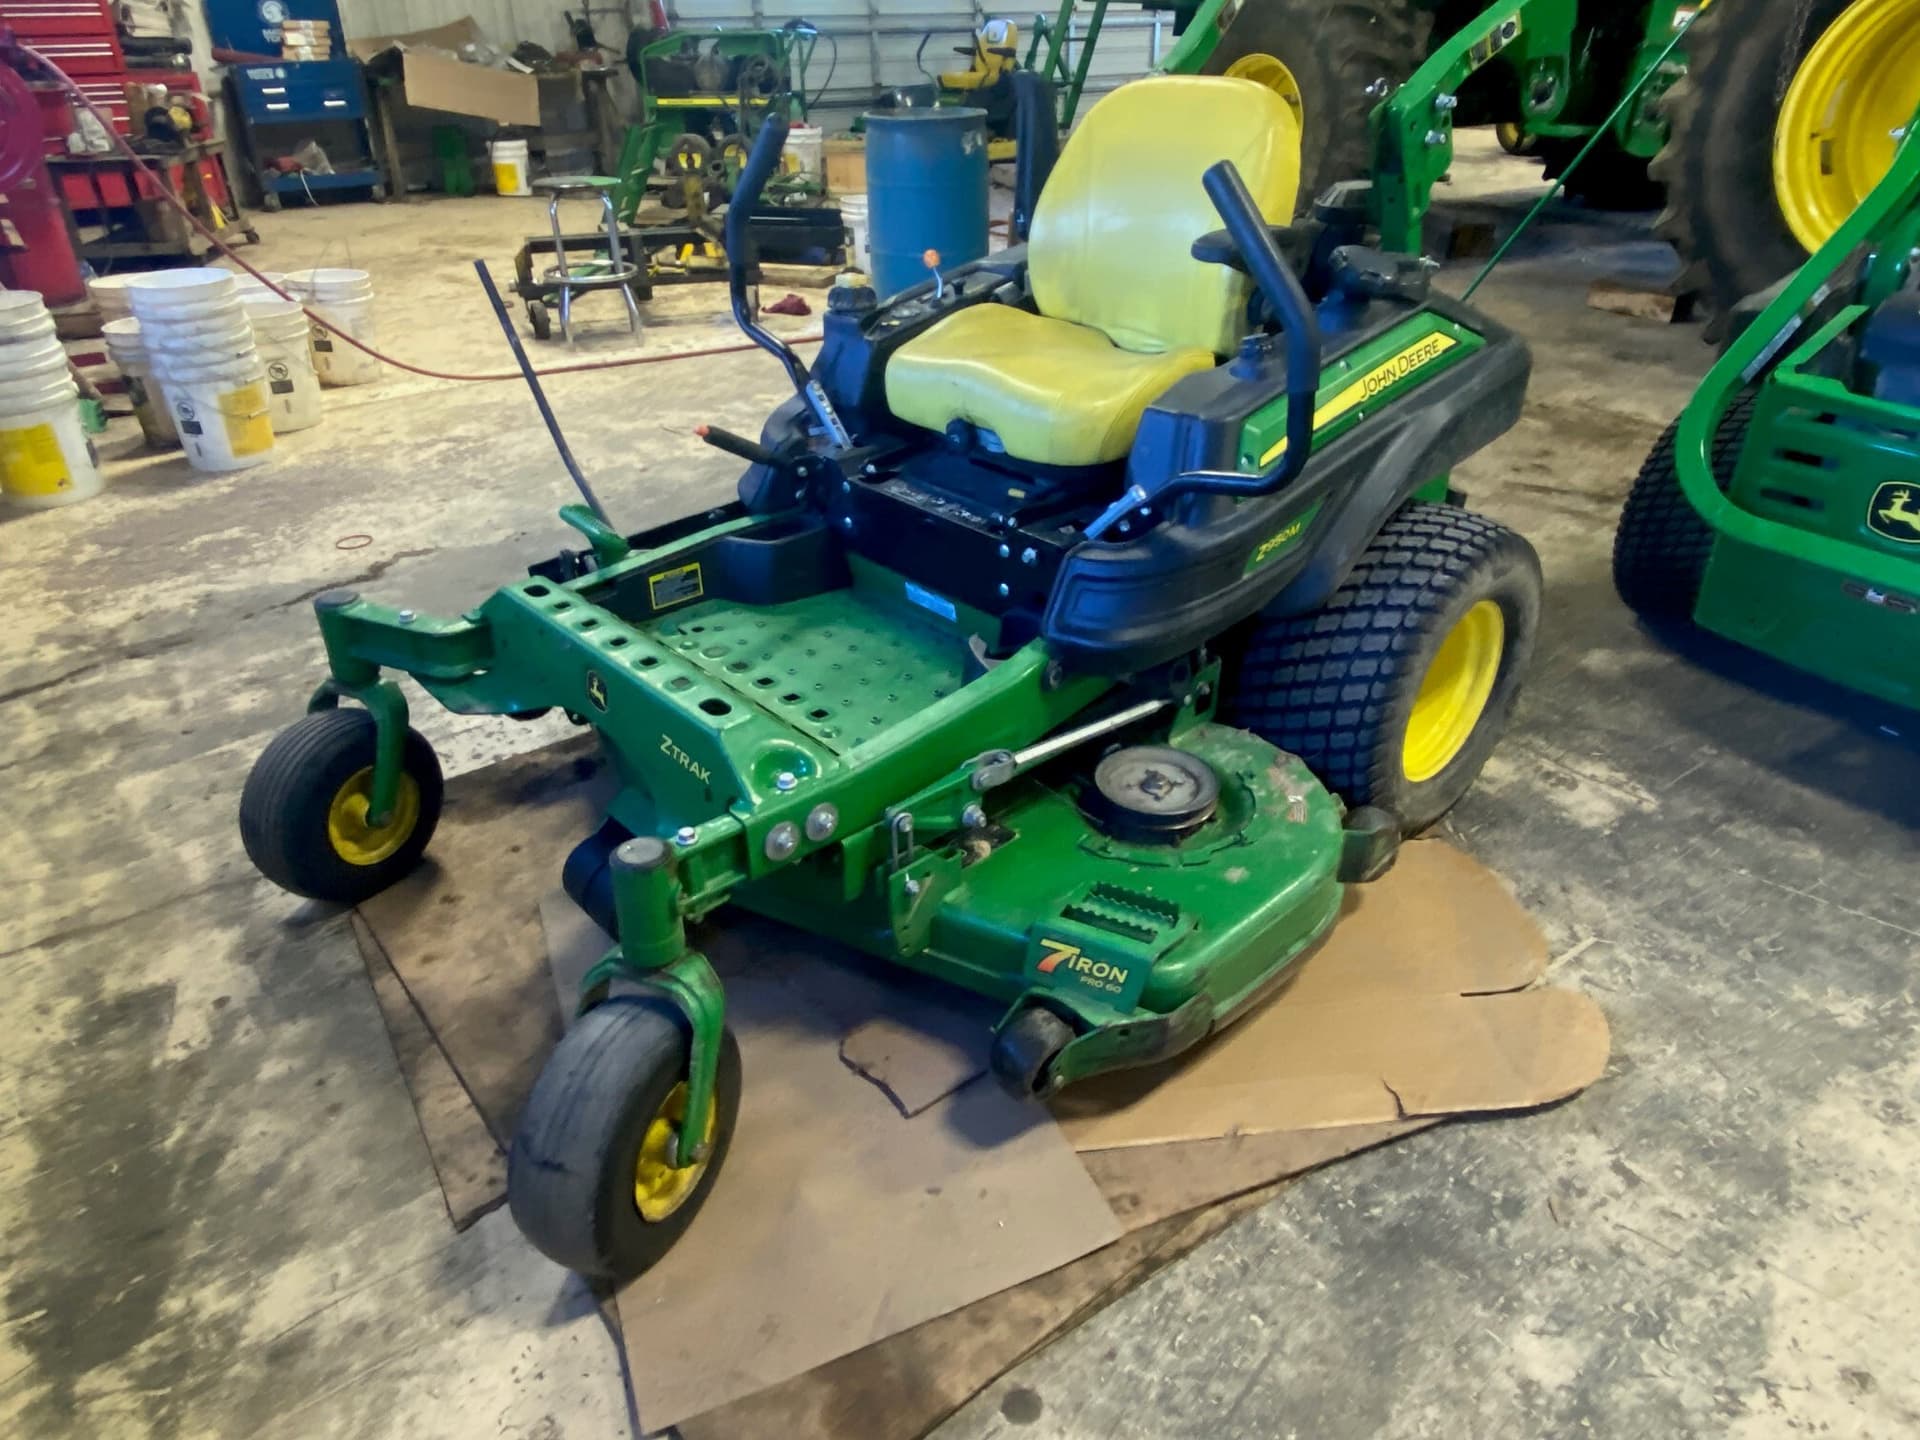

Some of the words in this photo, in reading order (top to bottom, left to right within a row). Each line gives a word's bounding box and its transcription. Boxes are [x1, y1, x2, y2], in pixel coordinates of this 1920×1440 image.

[1360, 363, 1397, 400] JOHN
[1398, 338, 1441, 375] DEERE
[659, 732, 713, 785] ZTRAK
[1079, 975, 1104, 989] PRO
[1105, 983, 1123, 995] 60
